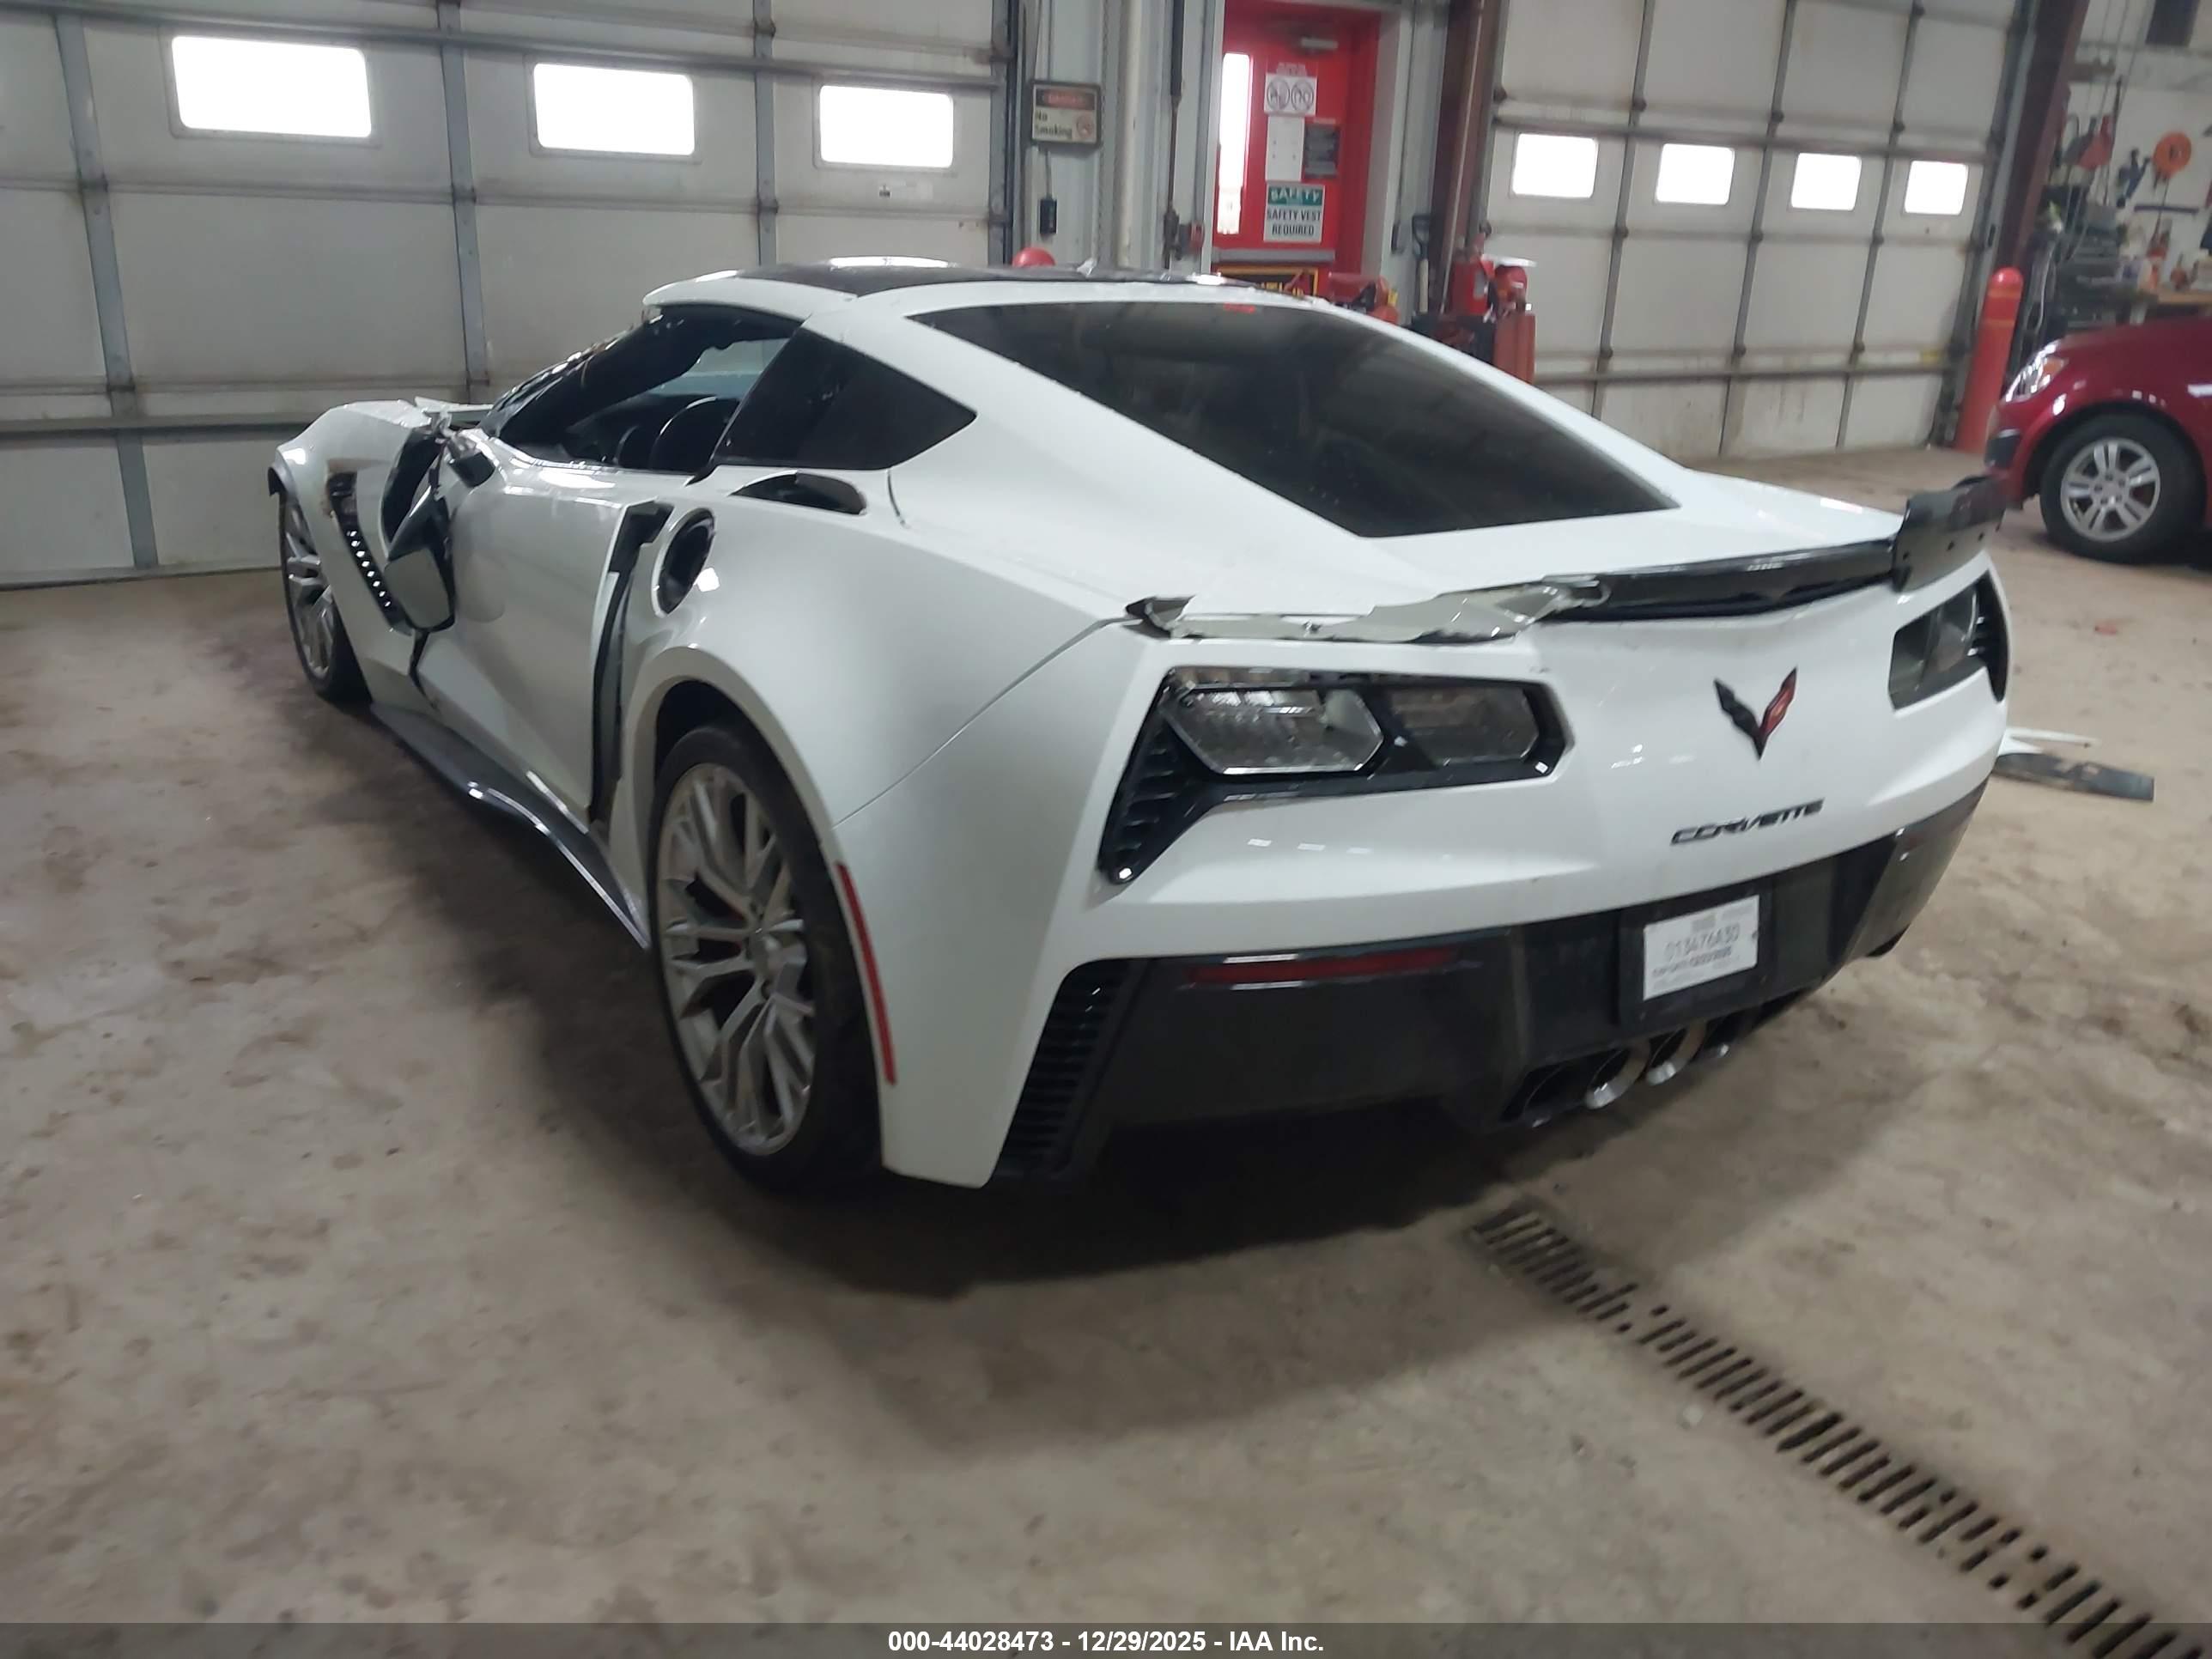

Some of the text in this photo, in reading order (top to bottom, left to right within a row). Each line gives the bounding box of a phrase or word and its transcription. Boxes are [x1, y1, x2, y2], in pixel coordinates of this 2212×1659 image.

[1271, 187, 1320, 203] SAFETY
[1267, 209, 1321, 221] SAFETY VEST
[1272, 224, 1315, 235] REQUIRED
[1670, 799, 1823, 845] CORVETTE
